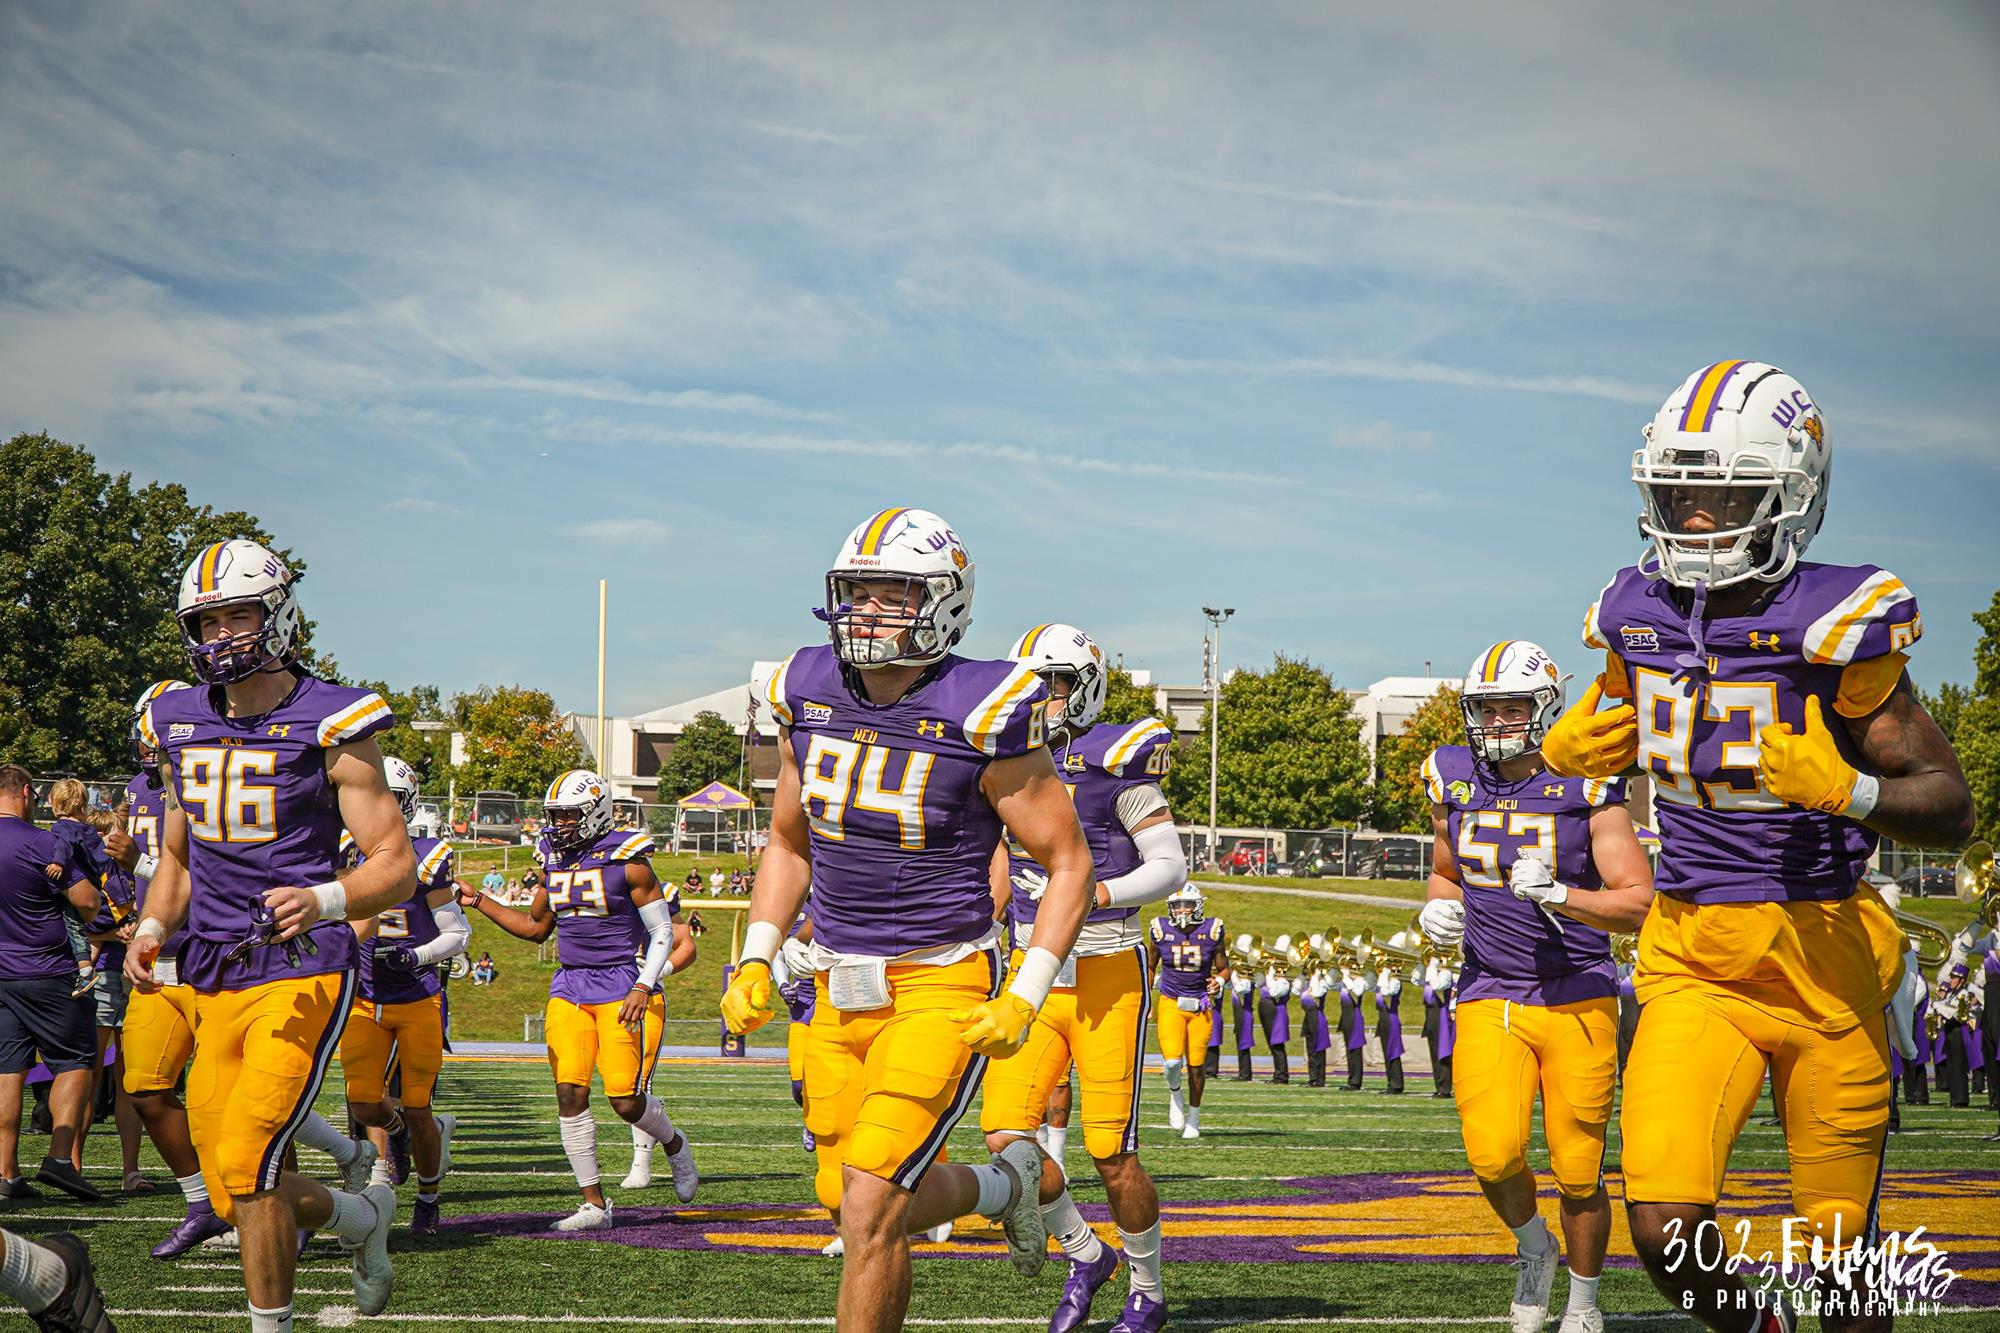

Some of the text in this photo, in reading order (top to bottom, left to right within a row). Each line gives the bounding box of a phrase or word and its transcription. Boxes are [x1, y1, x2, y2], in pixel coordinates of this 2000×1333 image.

[849, 557, 880, 566] Riddell
[194, 591, 222, 604] Riddell
[1624, 635, 1656, 647] PSAC
[806, 709, 830, 719] PSAC
[1027, 700, 1049, 749] 8
[170, 728, 193, 736] PSAC
[852, 728, 878, 744] WCU
[181, 747, 278, 842] 96
[801, 733, 937, 849] 84
[1496, 799, 1518, 810] WCU
[128, 815, 160, 858] 7
[1458, 811, 1558, 888] 53
[548, 868, 610, 917] 23
[1171, 944, 1201, 973] 13
